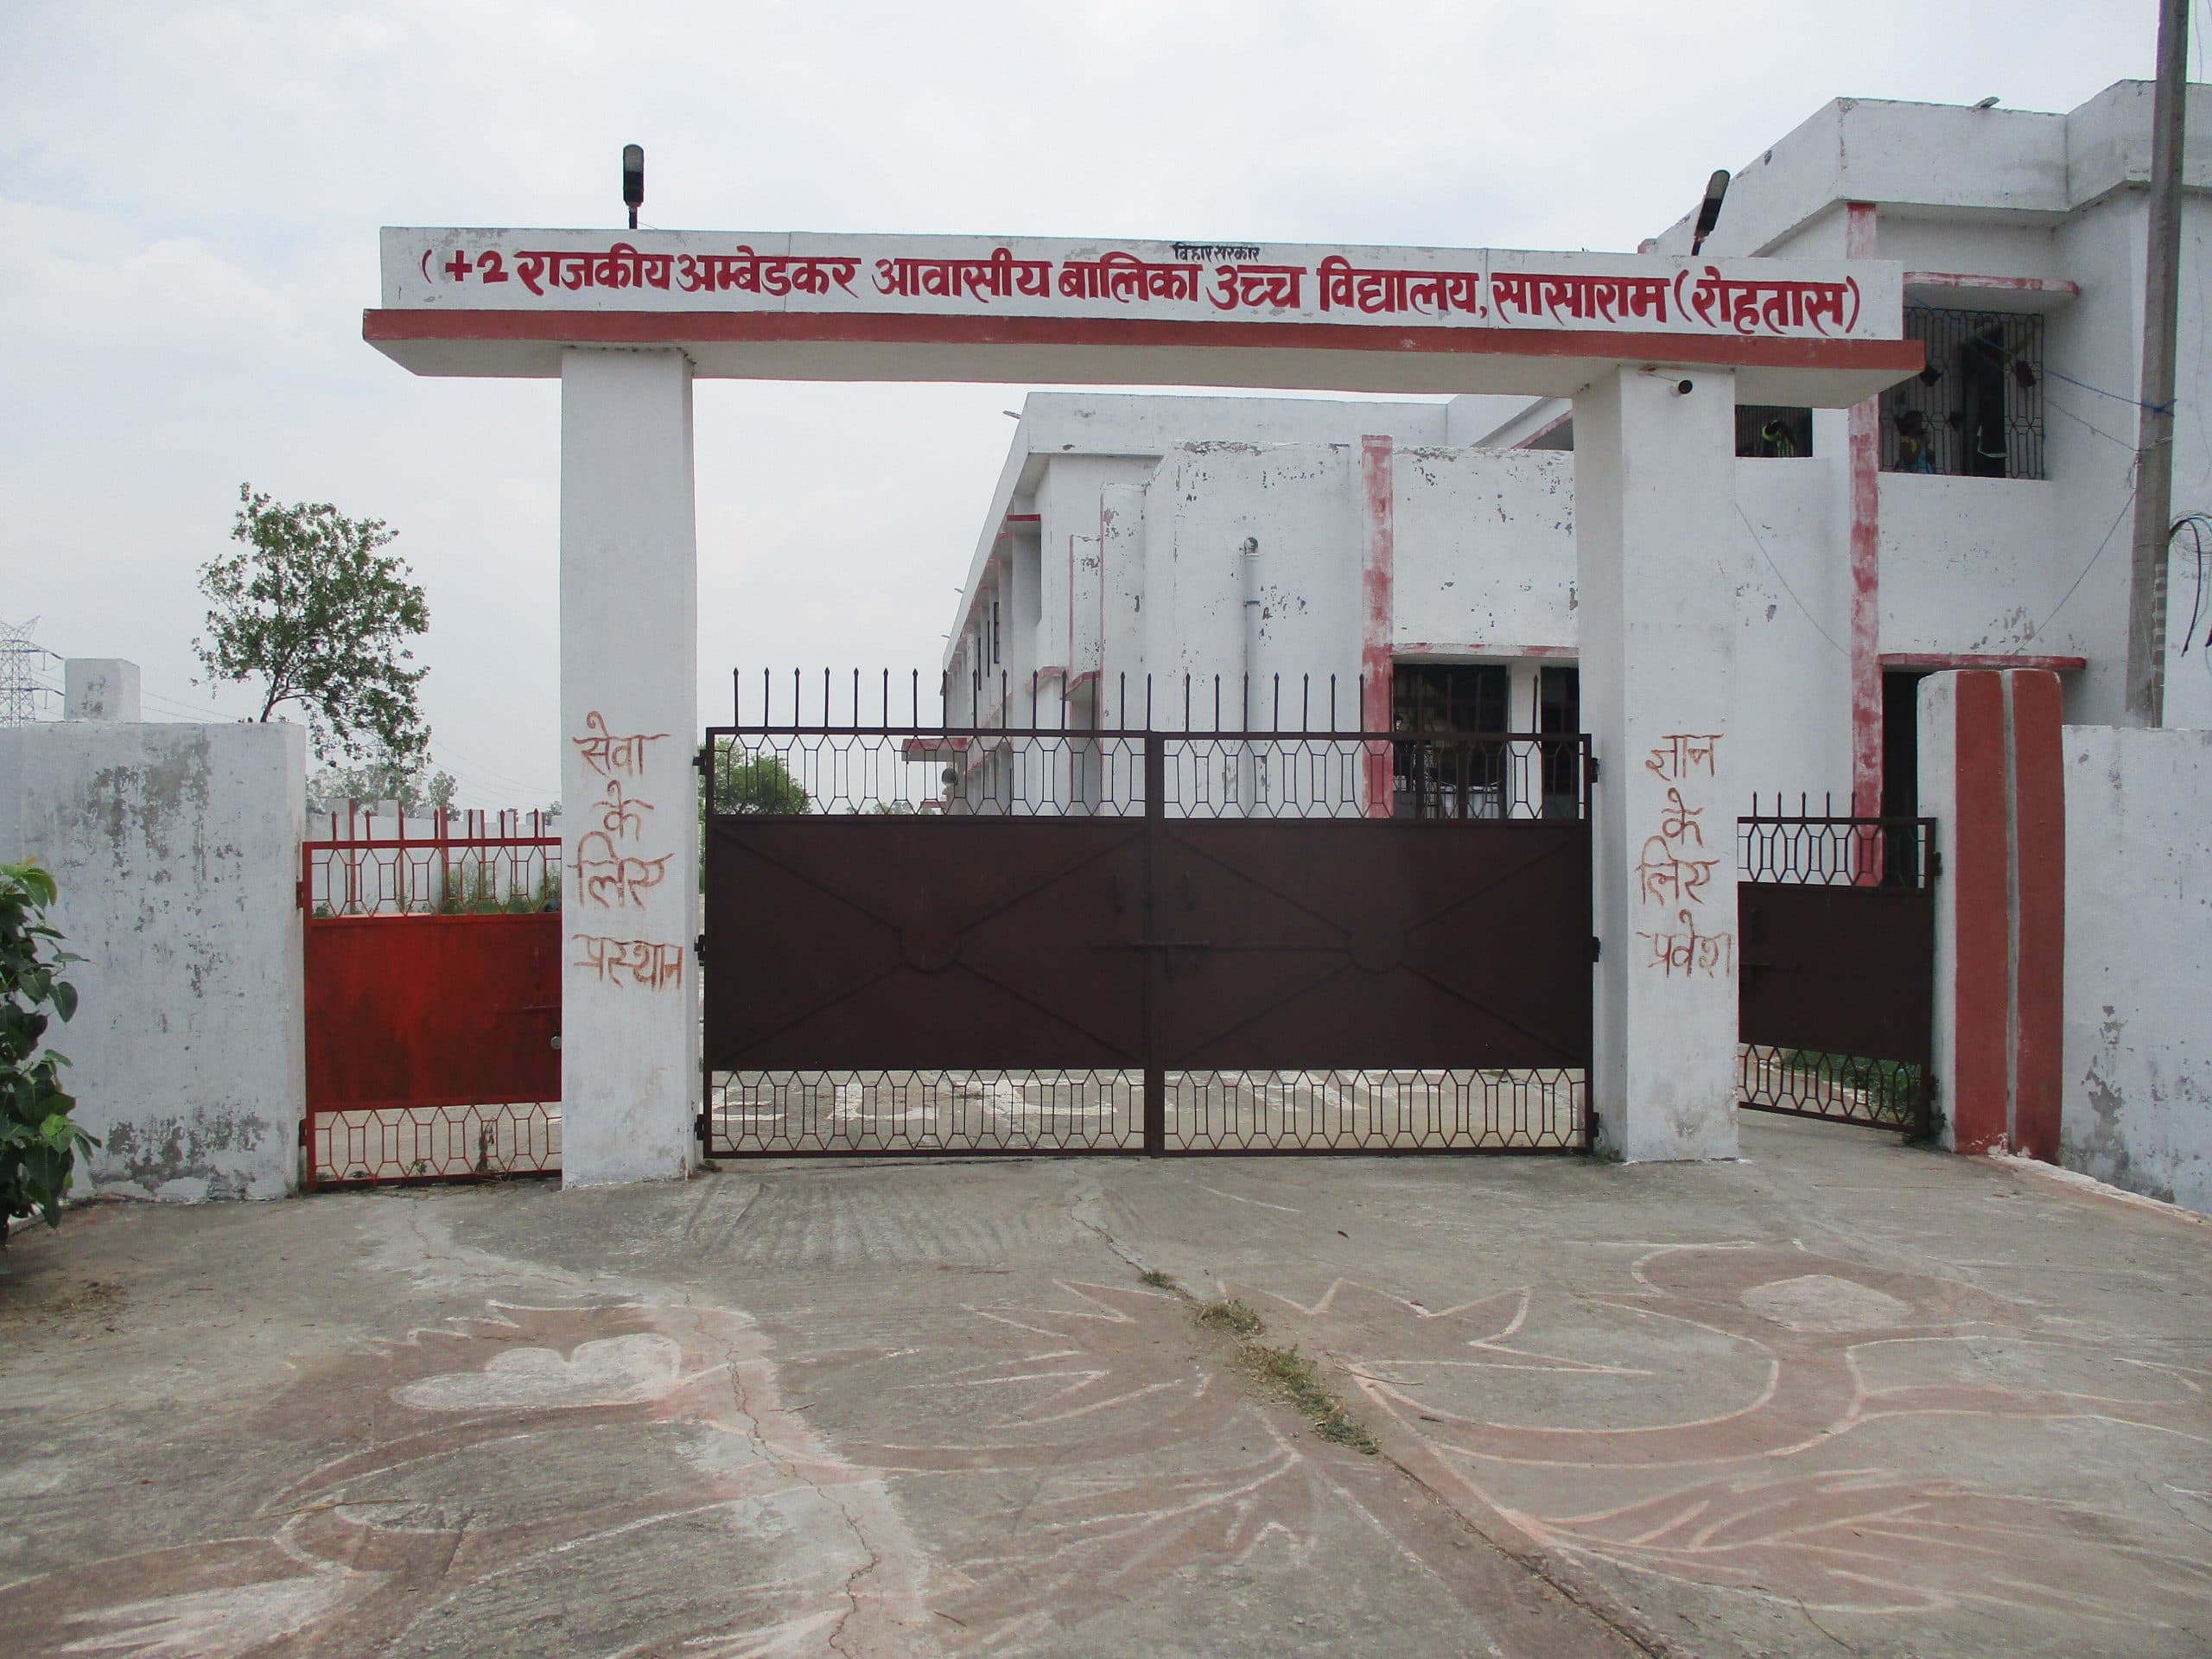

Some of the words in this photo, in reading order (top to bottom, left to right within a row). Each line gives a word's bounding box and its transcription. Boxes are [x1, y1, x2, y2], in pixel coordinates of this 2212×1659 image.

[514, 243, 674, 296] राजकीय
[676, 245, 861, 298] अम्बेडकर
[872, 247, 1052, 303] आवासीय
[1058, 251, 1203, 303] बालिका
[1206, 264, 1306, 310] उच्च
[1674, 265, 1860, 336] (रोहतास)
[592, 779, 655, 842] के
[1661, 787, 1704, 849] के
